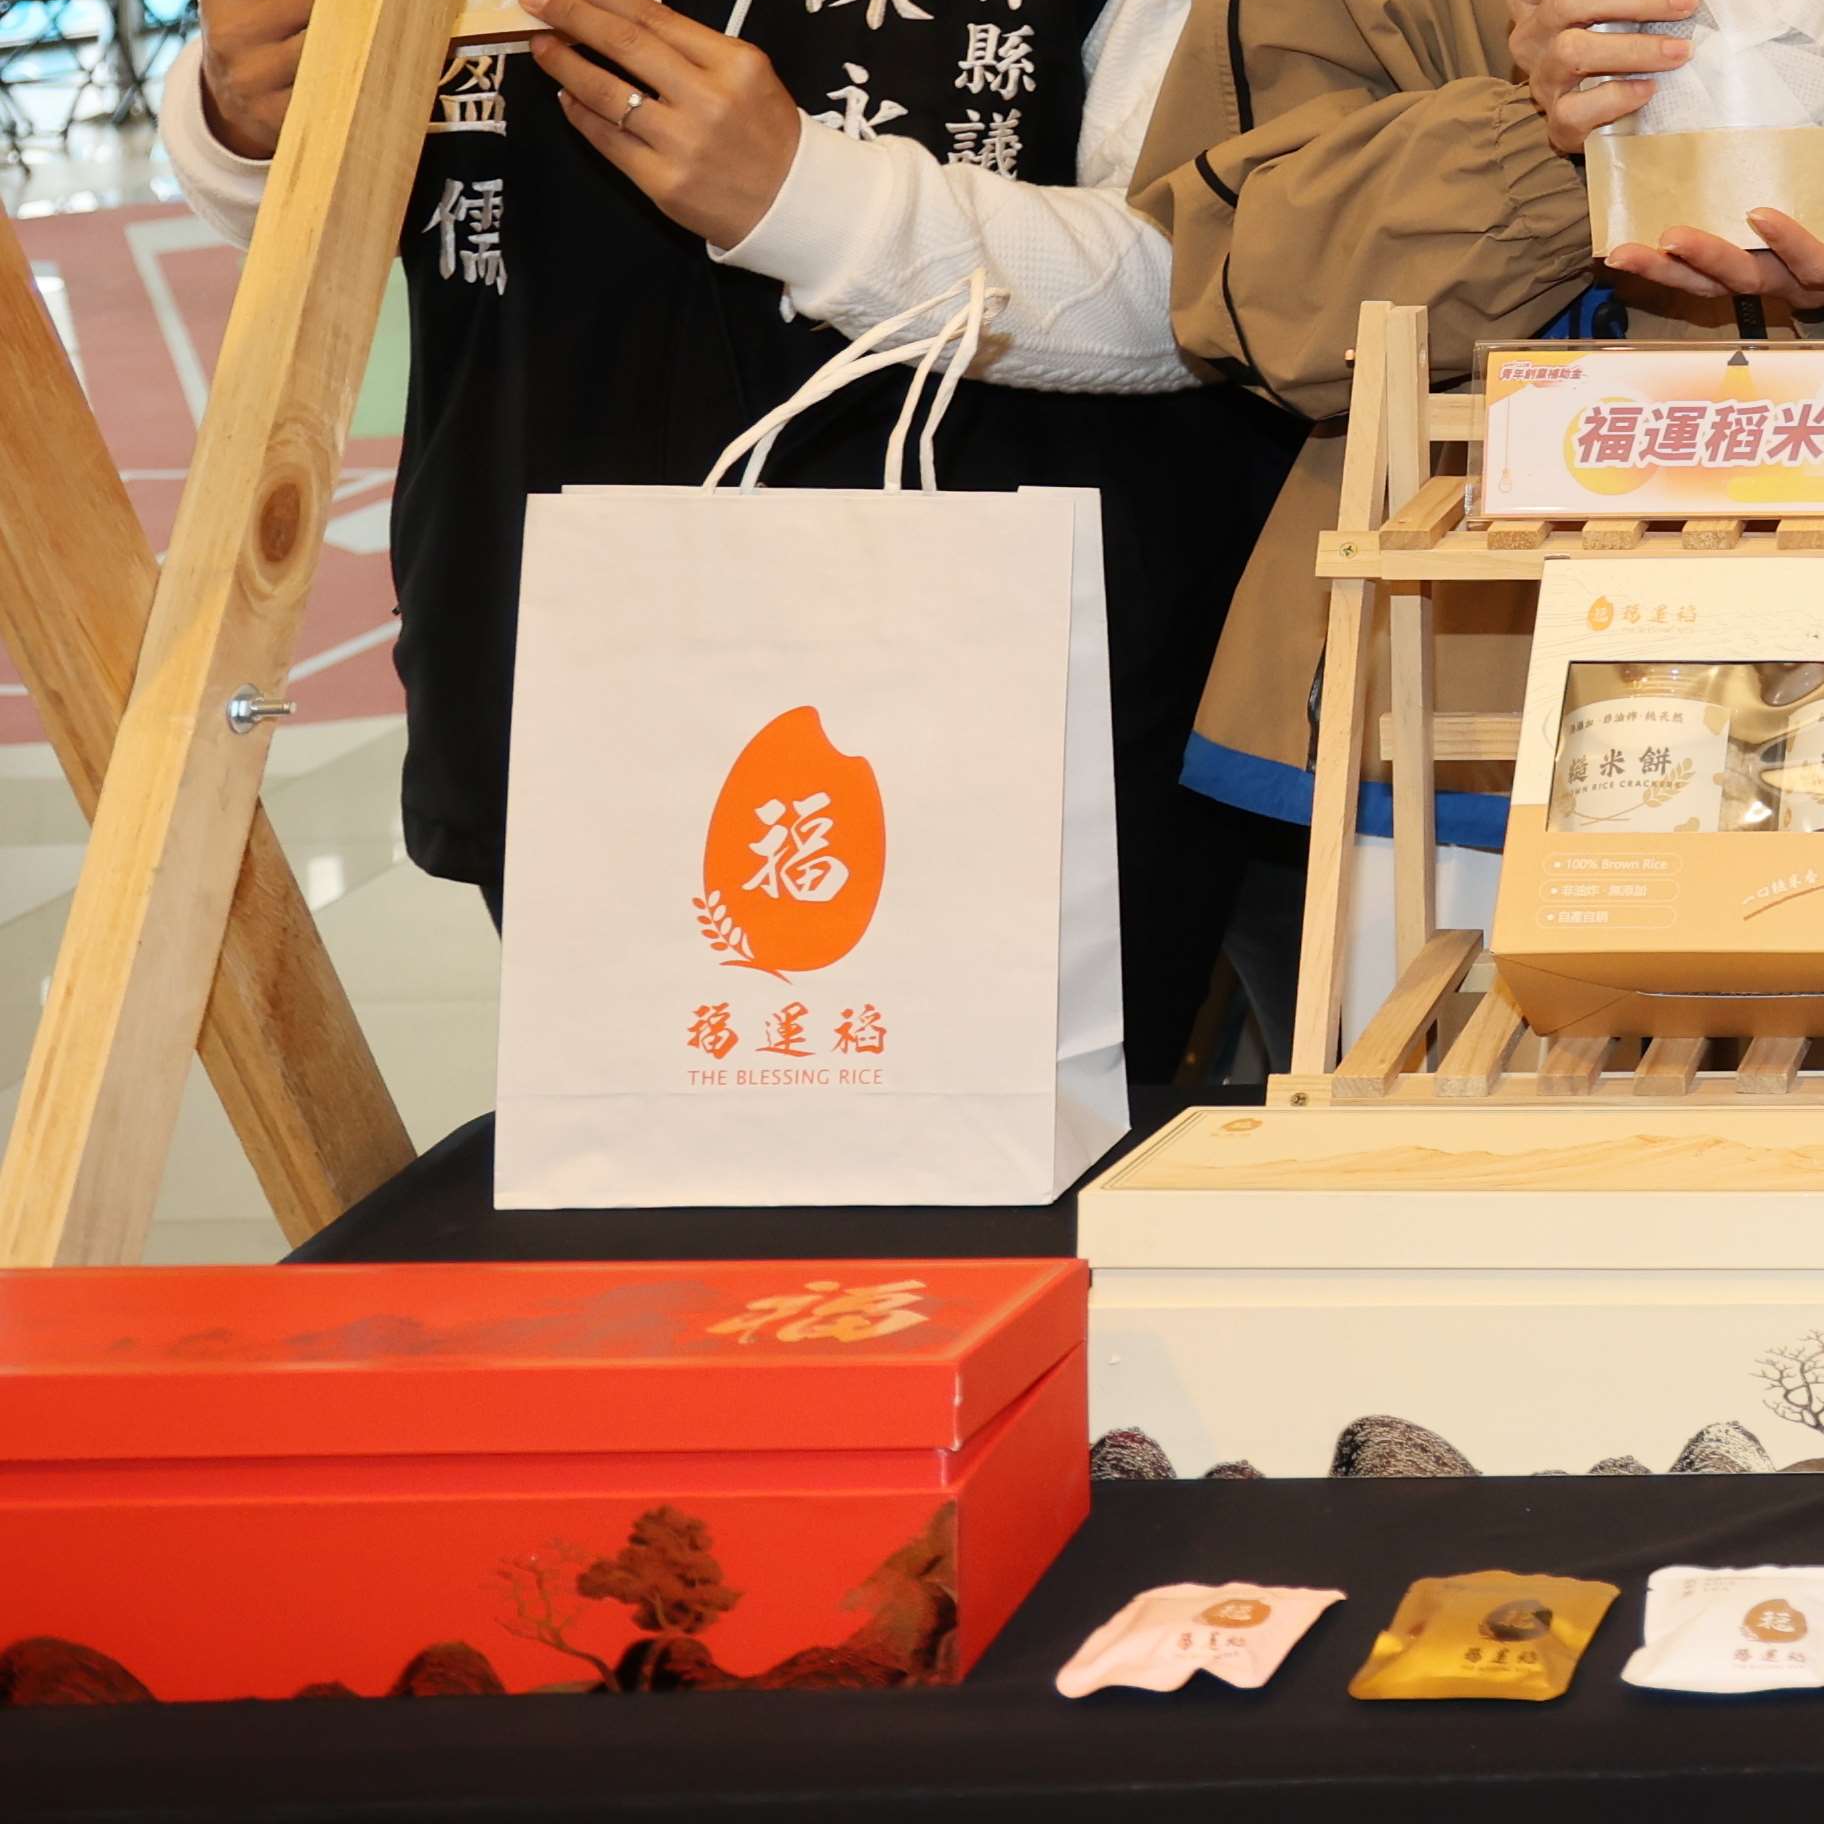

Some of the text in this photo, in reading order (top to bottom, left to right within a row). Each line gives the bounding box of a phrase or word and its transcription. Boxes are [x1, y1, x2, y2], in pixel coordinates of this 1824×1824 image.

[1568, 745, 1673, 784] 糙米餅
[741, 792, 850, 903] 福
[1566, 857, 1669, 871] 100% Brown Rice
[686, 1001, 890, 1059] 福運稻
[688, 1069, 885, 1087] THE BLESSING RICE
[706, 1279, 930, 1346] 福
[1757, 1610, 1795, 1633] 福
